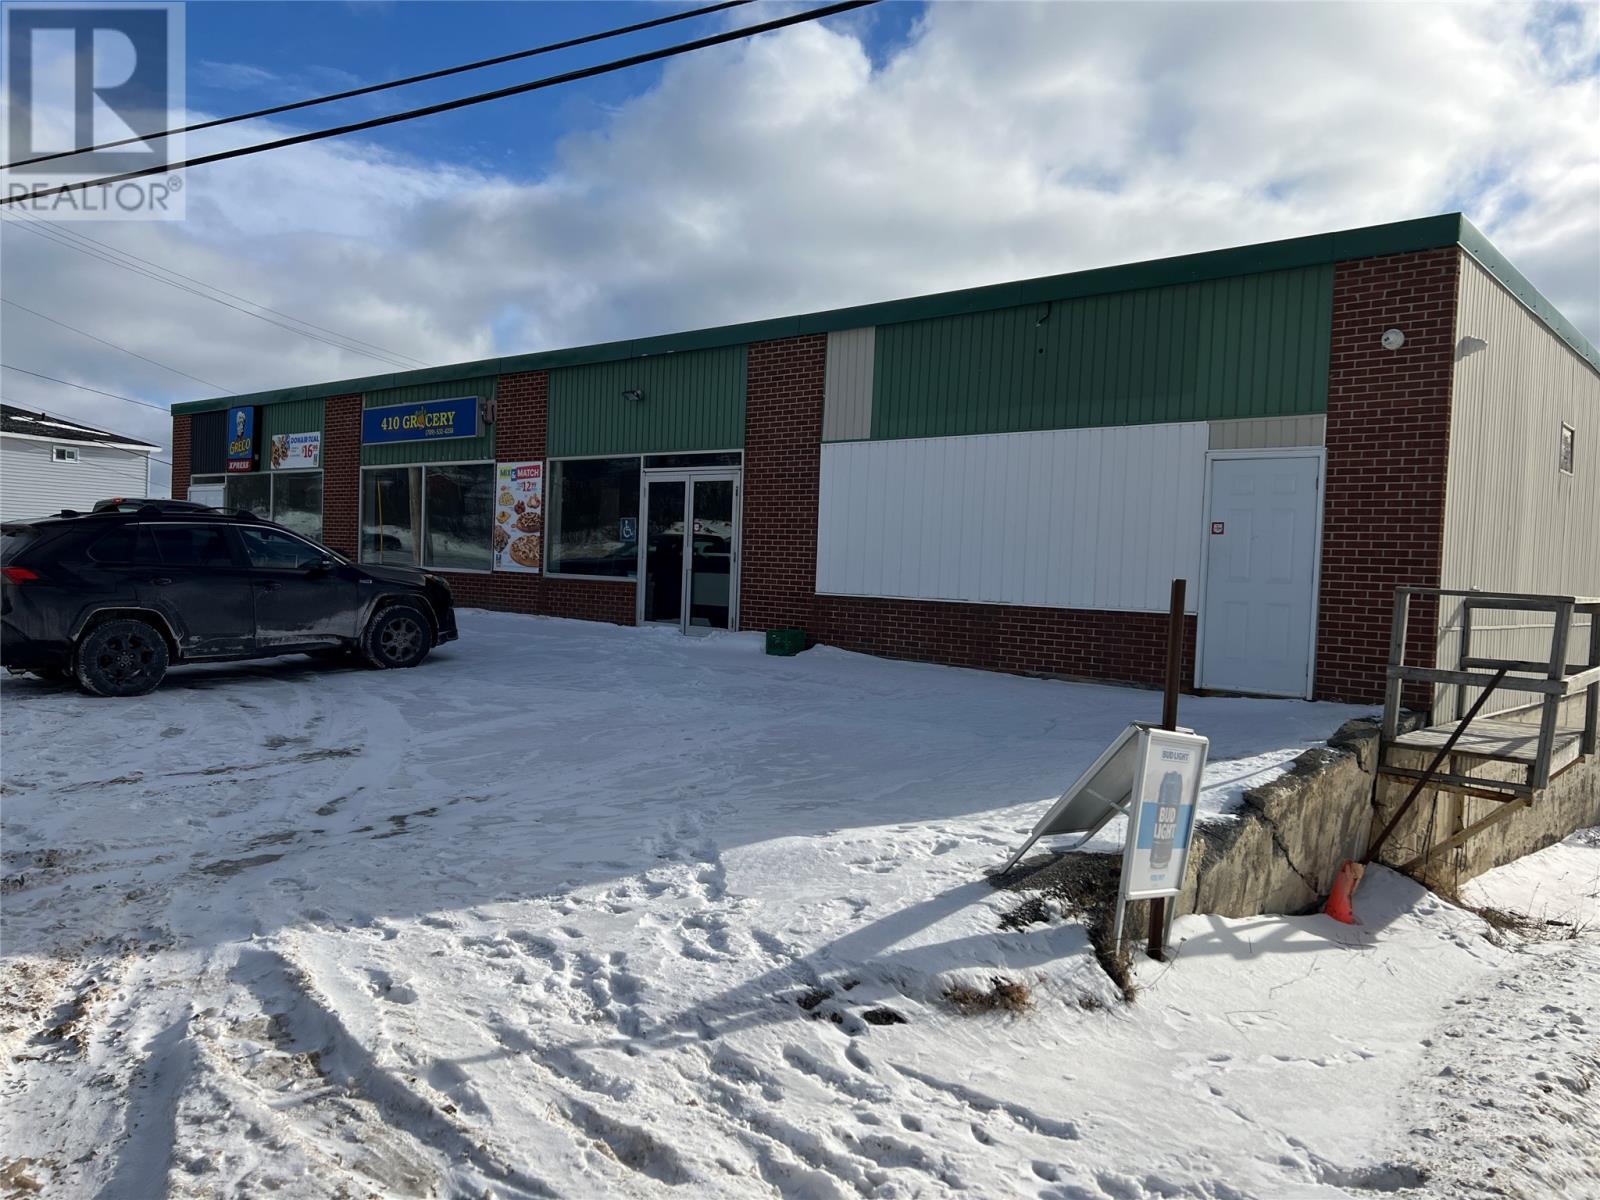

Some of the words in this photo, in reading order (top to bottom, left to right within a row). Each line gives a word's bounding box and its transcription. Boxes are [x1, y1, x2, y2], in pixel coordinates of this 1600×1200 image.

[381, 417, 400, 430] 410
[402, 411, 456, 429] GROCERY
[517, 468, 540, 478] MATCH
[1159, 807, 1177, 823] BUD
[1153, 823, 1177, 840] LIGHT
